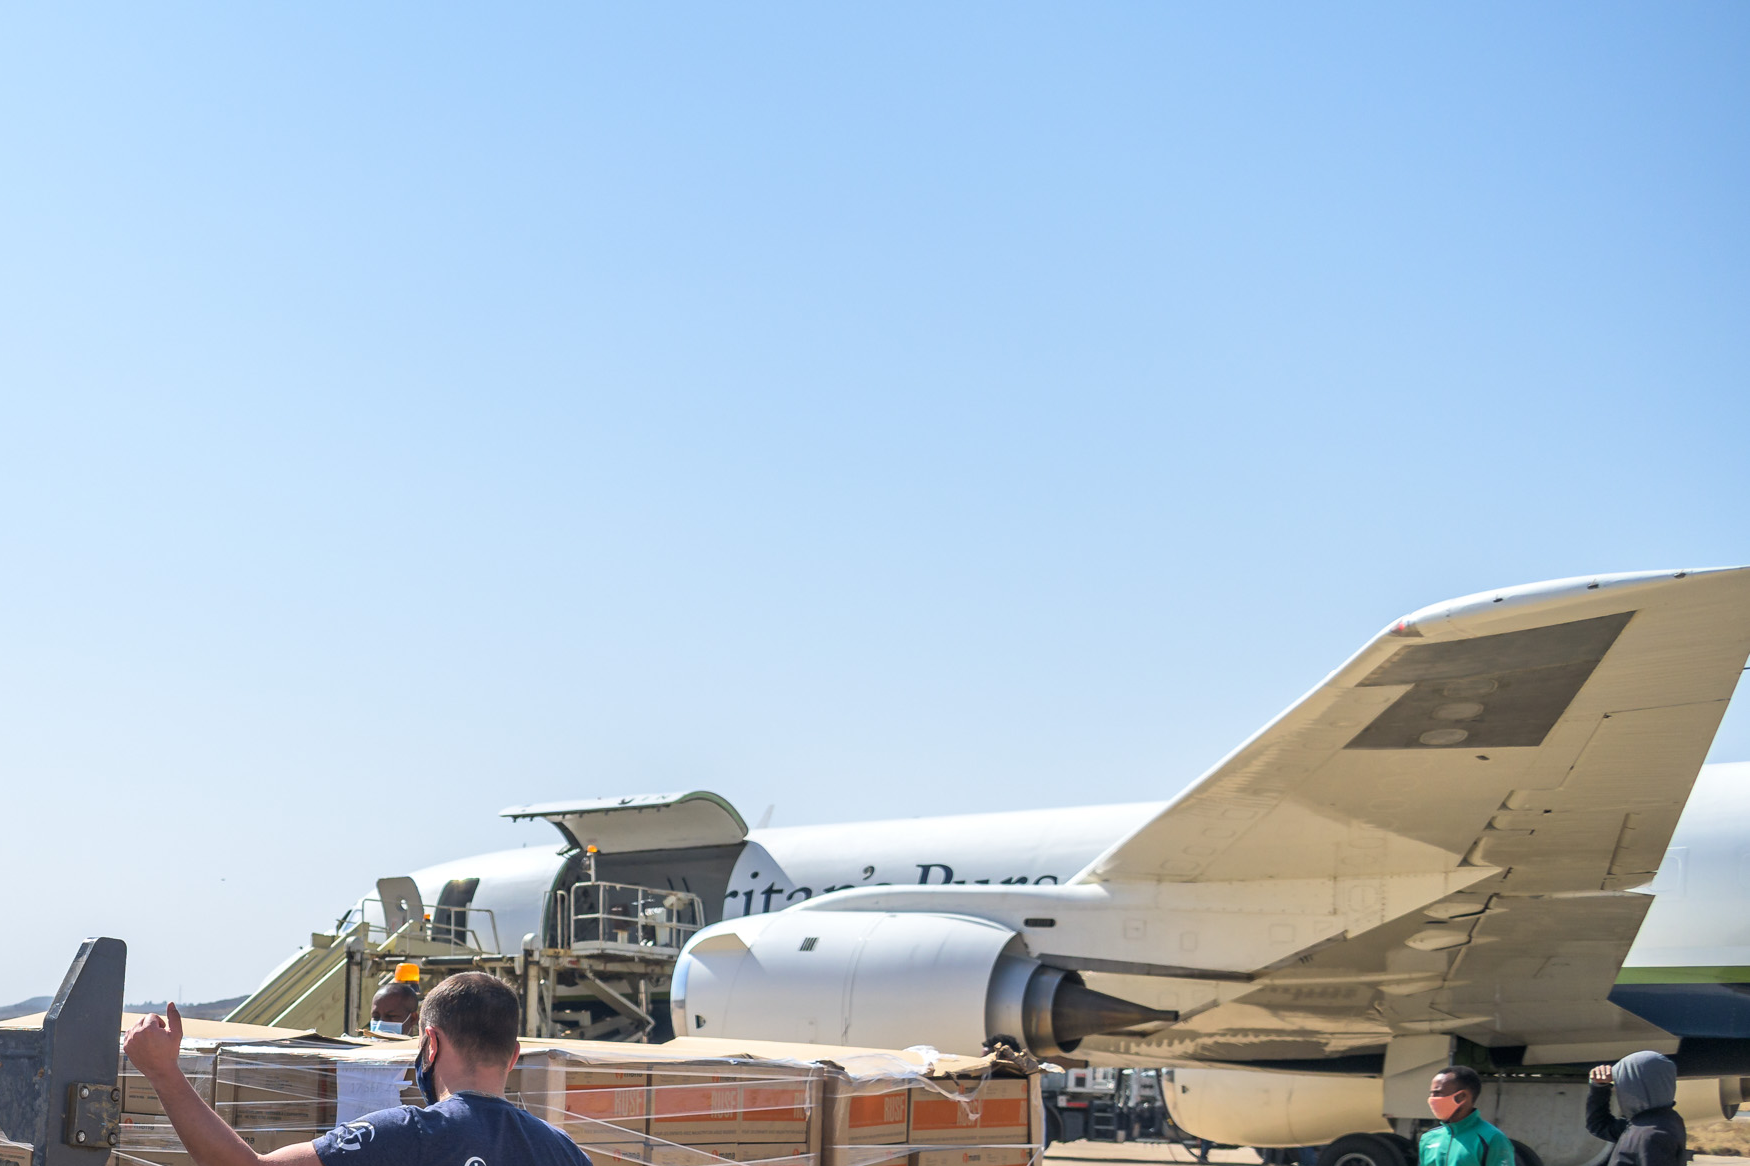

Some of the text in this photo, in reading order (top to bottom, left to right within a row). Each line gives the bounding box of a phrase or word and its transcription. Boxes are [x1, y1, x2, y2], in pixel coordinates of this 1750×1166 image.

[614, 1089, 642, 1117] RUSF
[710, 1090, 737, 1118] RUSF
[884, 1096, 905, 1122] RUSF
